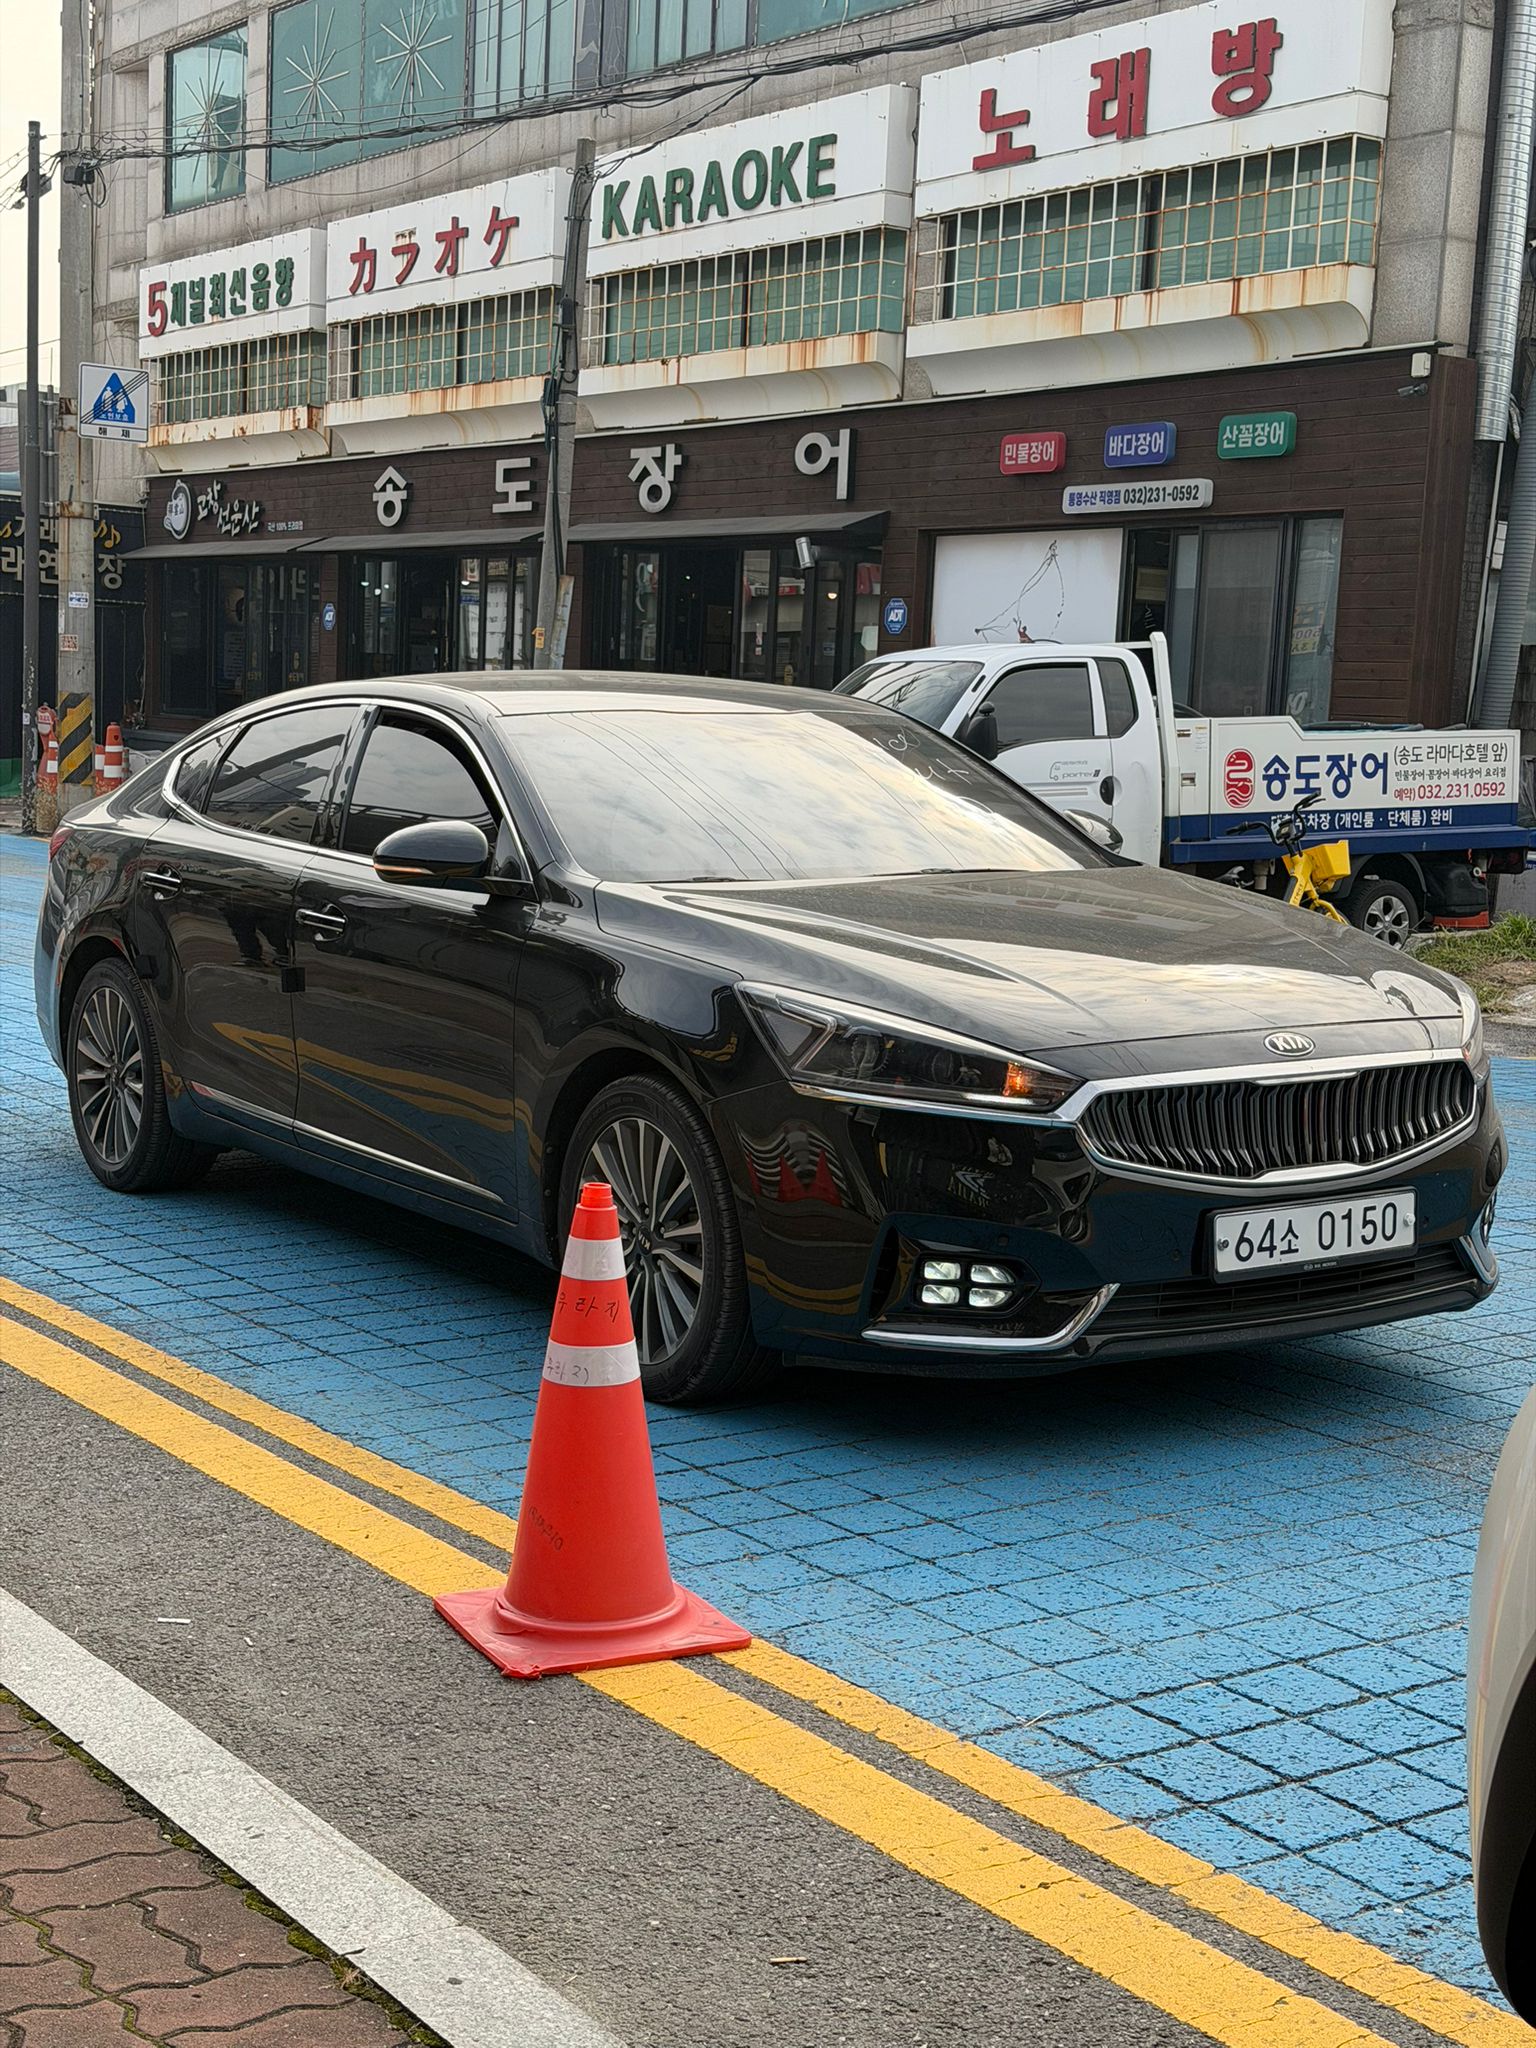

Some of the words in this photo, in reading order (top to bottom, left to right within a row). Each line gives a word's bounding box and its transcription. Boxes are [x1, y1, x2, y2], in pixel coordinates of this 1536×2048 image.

[972, 17, 1284, 171] 노래방
[602, 133, 838, 239] KARAOKE
[1108, 431, 1165, 457] 바다장어
[1222, 421, 1285, 449] 산꼼장어
[1004, 441, 1055, 465] 민물장어
[197, 480, 221, 520] 고창
[1068, 492, 1097, 507] 통영수산
[1099, 490, 1121, 505] 직영점
[1123, 485, 1200, 506] 032)231-0592
[217, 500, 260, 537] 선운산
[1394, 745, 1423, 766] (송도
[1426, 743, 1489, 764] 라마다호텔
[1491, 742, 1507, 762] 앞)
[1262, 752, 1388, 801] 송도장어
[1418, 781, 1506, 800] 032.231.0592
[1335, 811, 1374, 829] (개인룸
[1388, 809, 1427, 827] 단체룸)
[1430, 808, 1453, 825] 완비
[1271, 1035, 1310, 1051] KIA
[1235, 1219, 1299, 1262] 64소
[1318, 1202, 1398, 1251] 0150
